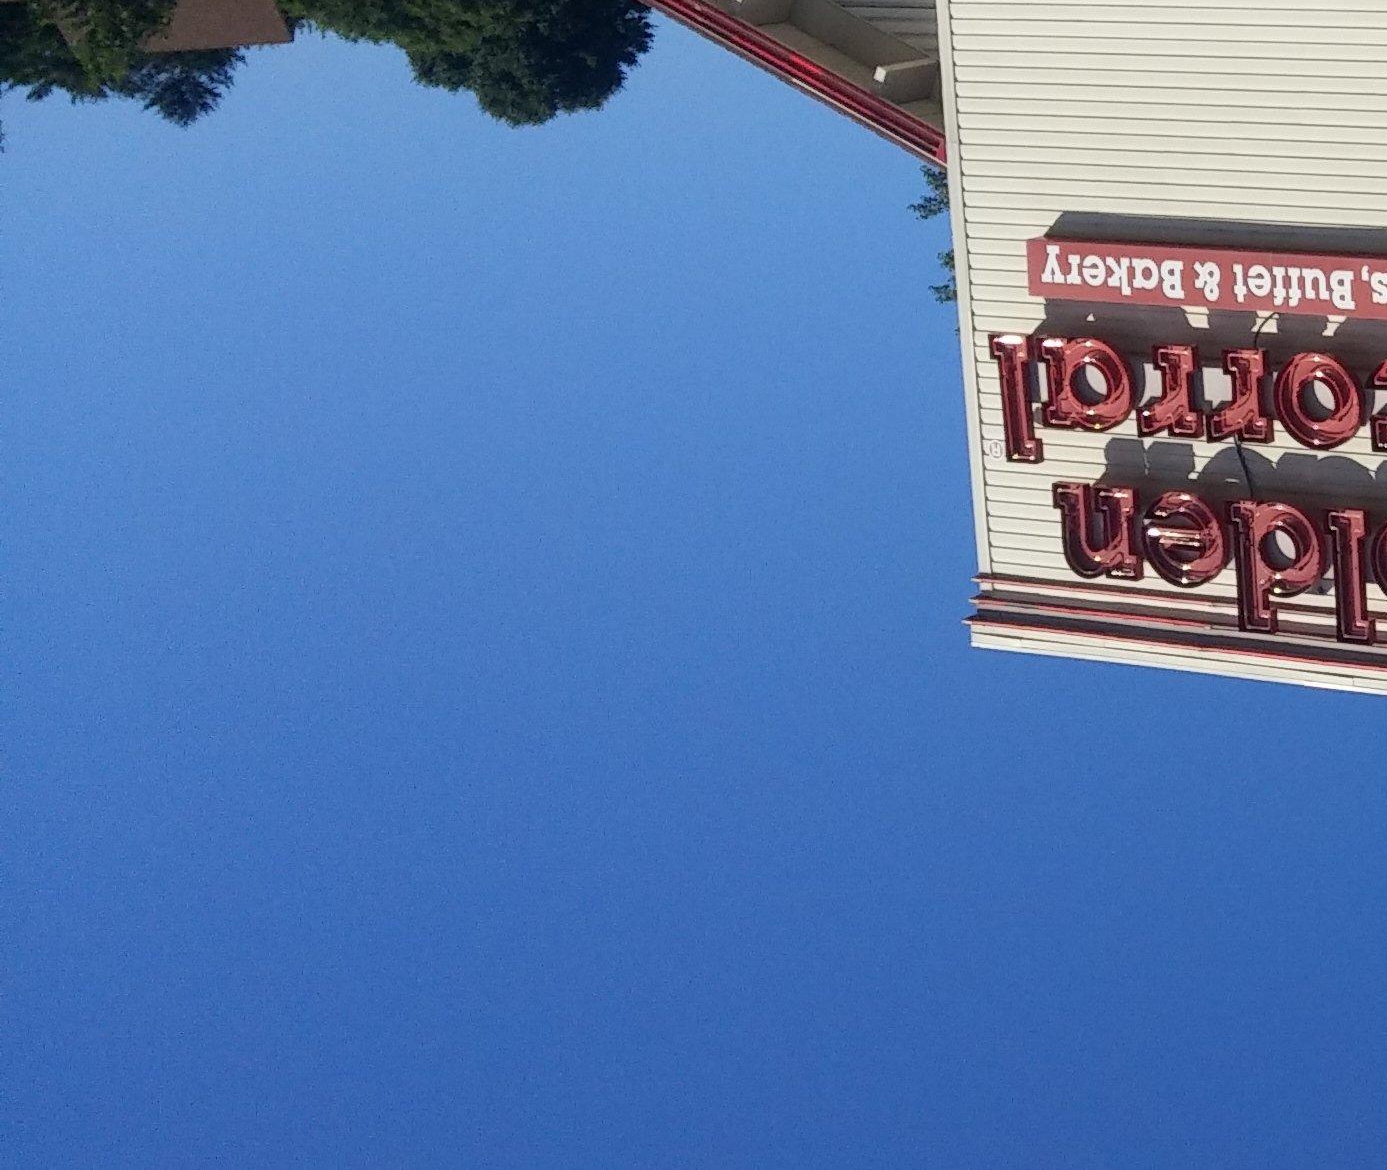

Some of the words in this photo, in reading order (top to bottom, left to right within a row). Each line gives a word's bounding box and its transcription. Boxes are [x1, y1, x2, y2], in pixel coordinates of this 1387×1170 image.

[1041, 245, 1184, 299] Bakery
[1193, 260, 1221, 302] &
[1232, 262, 1355, 310] Buffet
